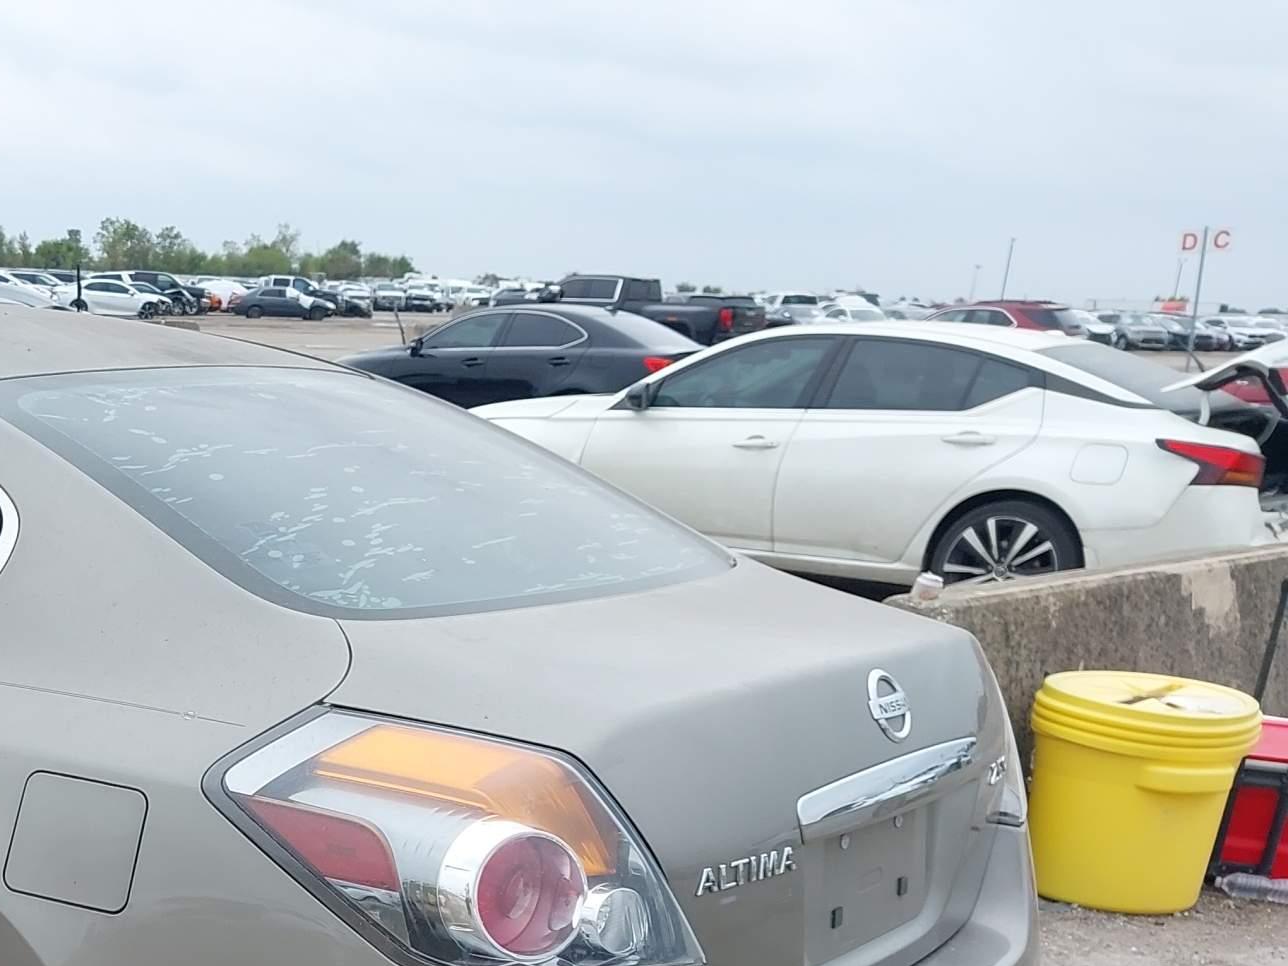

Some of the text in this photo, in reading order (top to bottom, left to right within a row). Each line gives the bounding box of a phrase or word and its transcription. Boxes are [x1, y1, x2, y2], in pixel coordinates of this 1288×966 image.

[1181, 232, 1198, 251] D
[1213, 229, 1231, 249] C
[695, 846, 797, 897] ALTIMA
